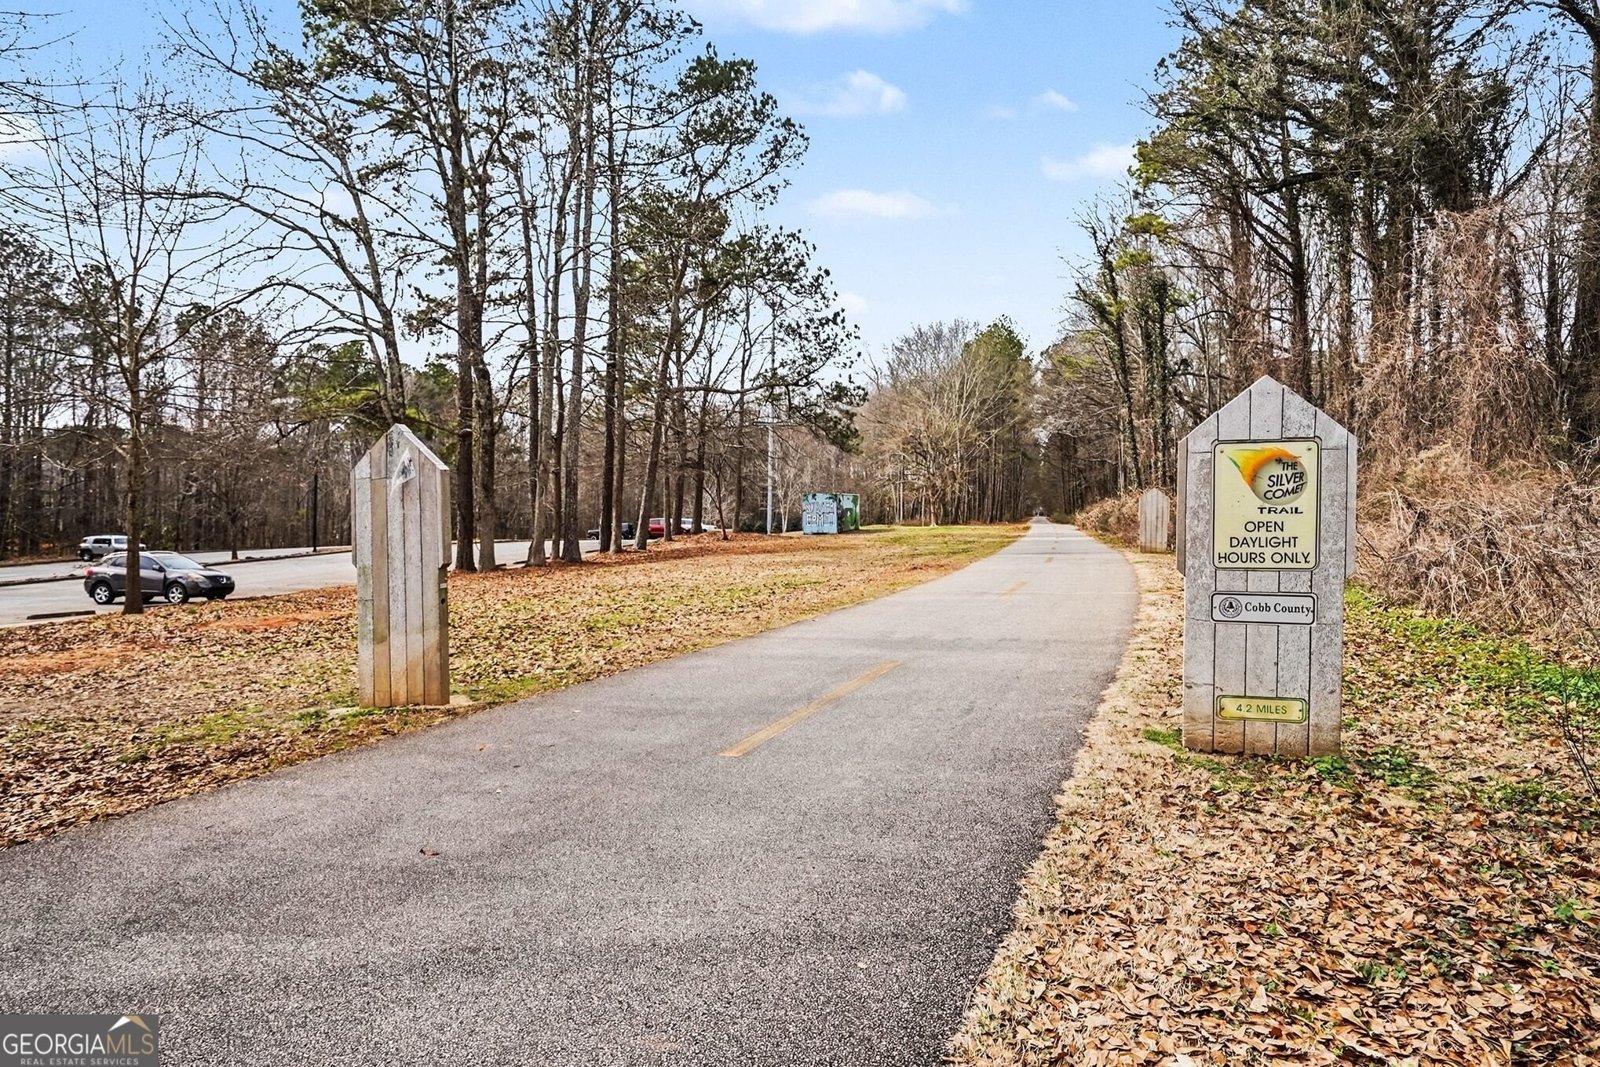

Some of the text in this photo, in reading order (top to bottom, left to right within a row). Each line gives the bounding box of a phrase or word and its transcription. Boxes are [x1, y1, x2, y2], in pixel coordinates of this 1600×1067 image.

[1281, 461, 1298, 471] THE
[1267, 471, 1304, 487] SILVER
[1263, 482, 1308, 500] COMET
[1244, 521, 1284, 533] OPEN
[1229, 536, 1298, 548] DAYLIGHT
[1218, 552, 1310, 564] HOURS ONLY
[1244, 602, 1271, 613] Cobb
[1273, 603, 1311, 617] County
[1236, 703, 1288, 714] 4.2 MILES
